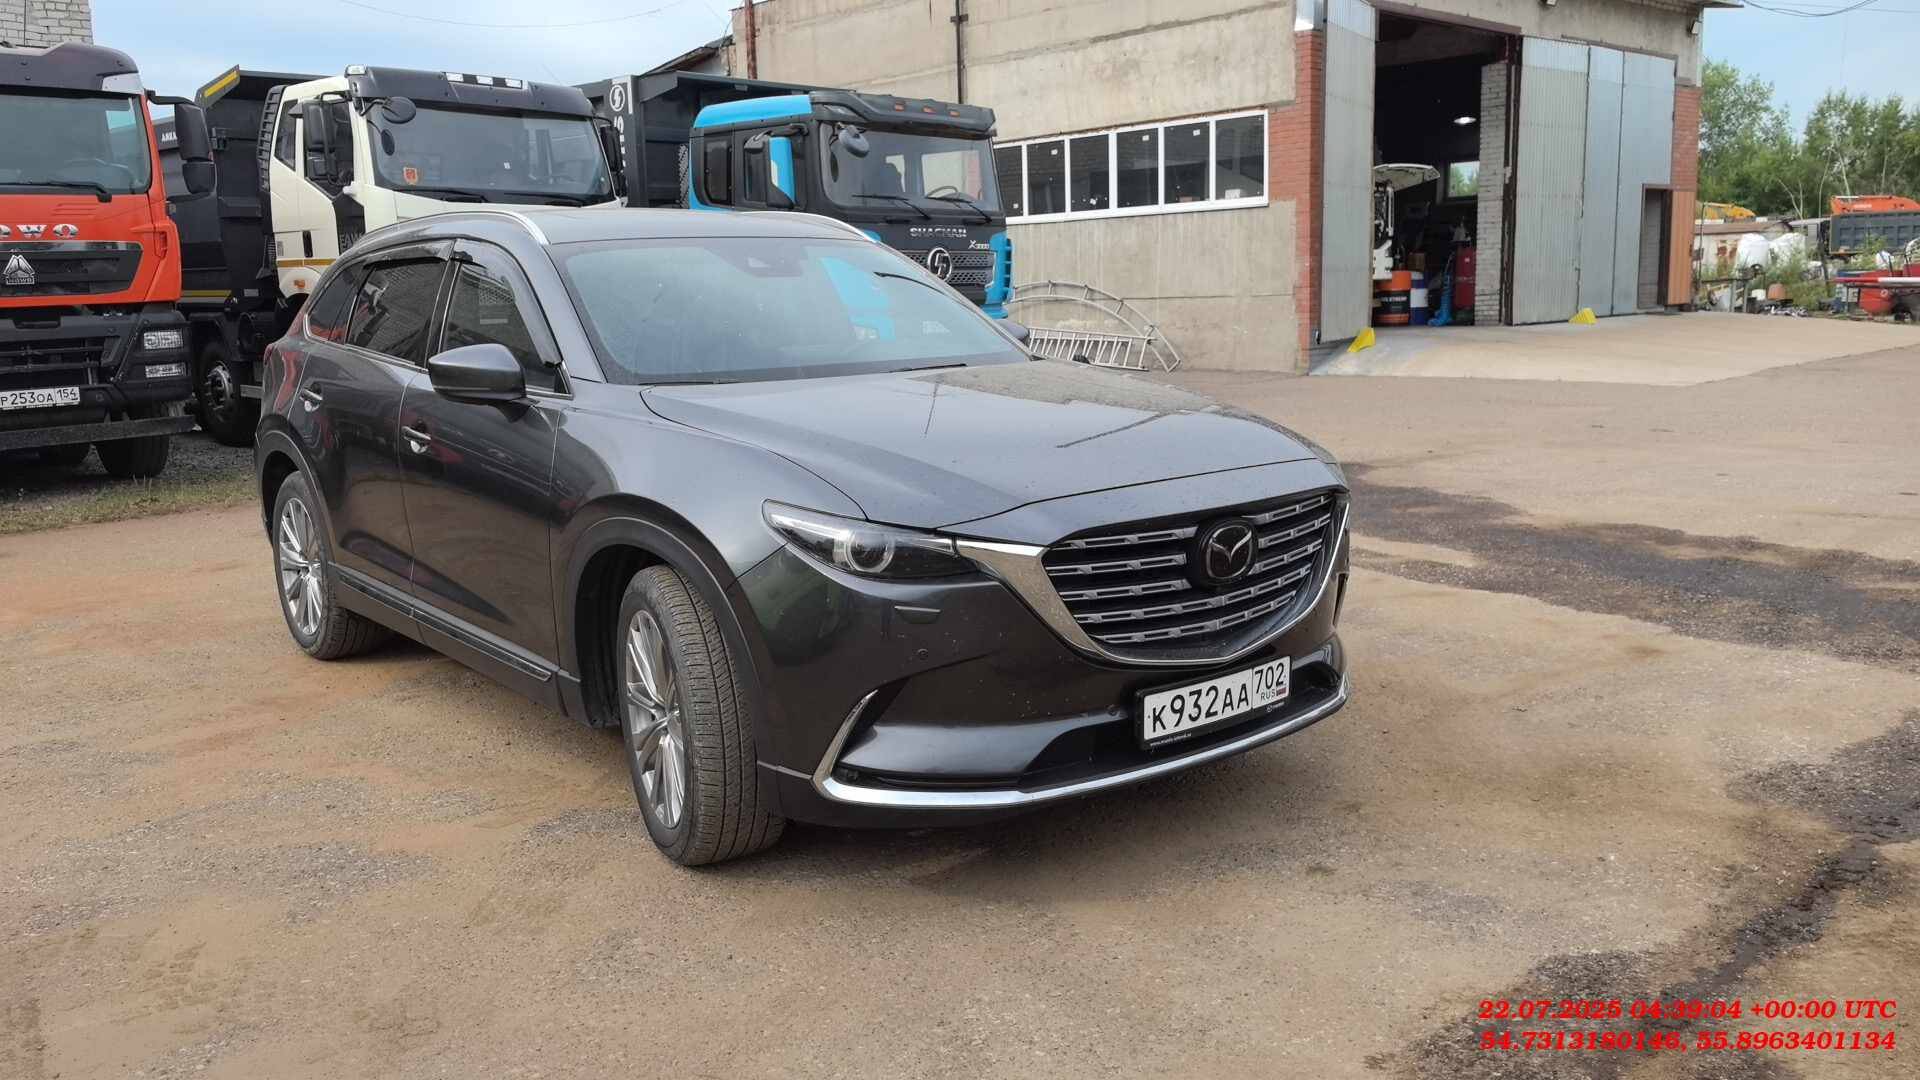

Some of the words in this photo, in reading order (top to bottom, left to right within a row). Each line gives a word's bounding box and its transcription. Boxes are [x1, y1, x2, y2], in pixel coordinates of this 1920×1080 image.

[56, 388, 78, 401] 154
[1151, 684, 1250, 733] К932АА
[1254, 662, 1285, 695] 702
[1260, 688, 1276, 701] RUS
